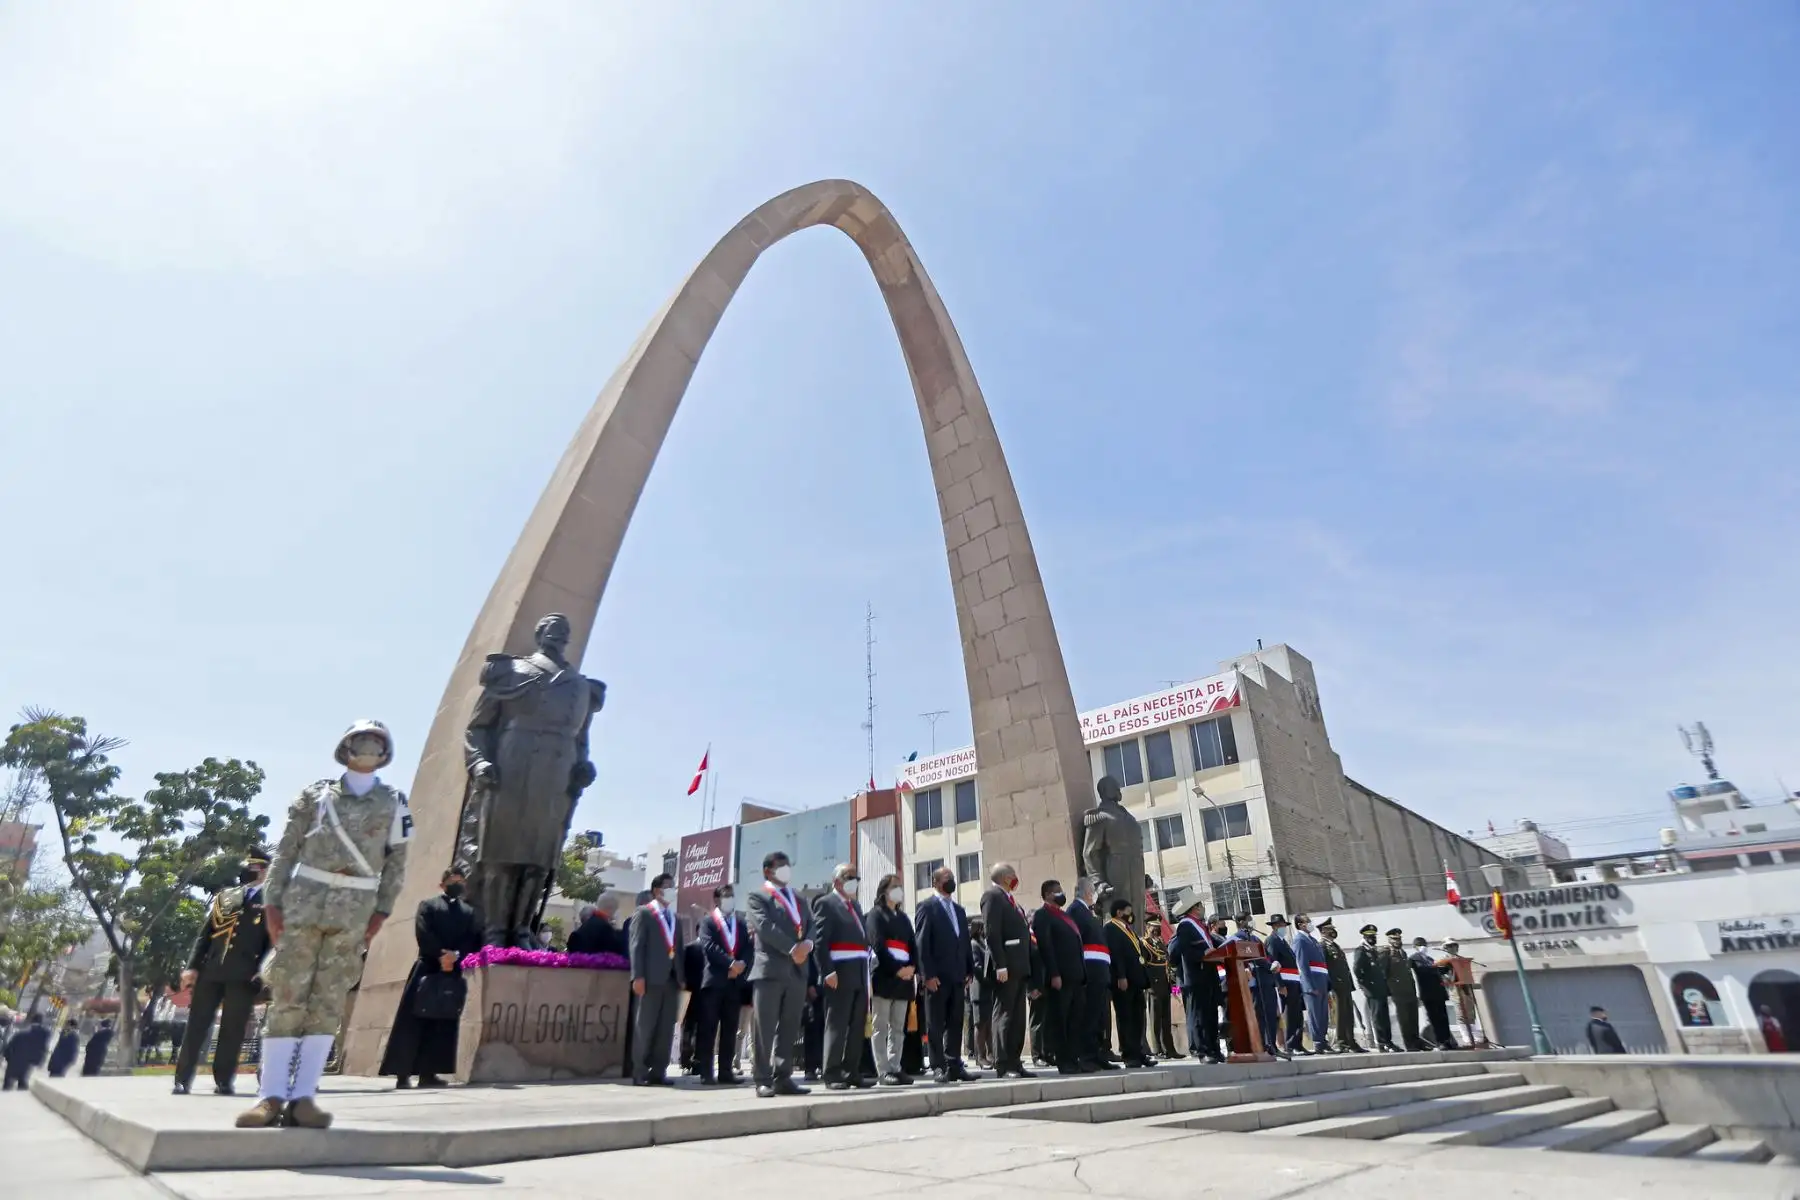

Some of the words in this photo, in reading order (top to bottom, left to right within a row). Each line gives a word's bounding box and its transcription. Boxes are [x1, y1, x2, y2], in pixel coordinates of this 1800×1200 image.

[920, 750, 976, 772] BICENTENAR
[1078, 716, 1093, 729] R,
[1096, 713, 1110, 725] EL
[1114, 703, 1140, 720] PAÍS
[1143, 687, 1203, 712] NECESITA
[1207, 681, 1225, 695] DE
[1082, 724, 1115, 741] LIDAD
[1119, 717, 1149, 732] ESOS
[685, 856, 724, 872] comienza
[691, 867, 724, 887] Patria!
[1459, 883, 1619, 914] ESTAIONAMIENTO
[487, 1002, 620, 1044] BOLOGNESI
